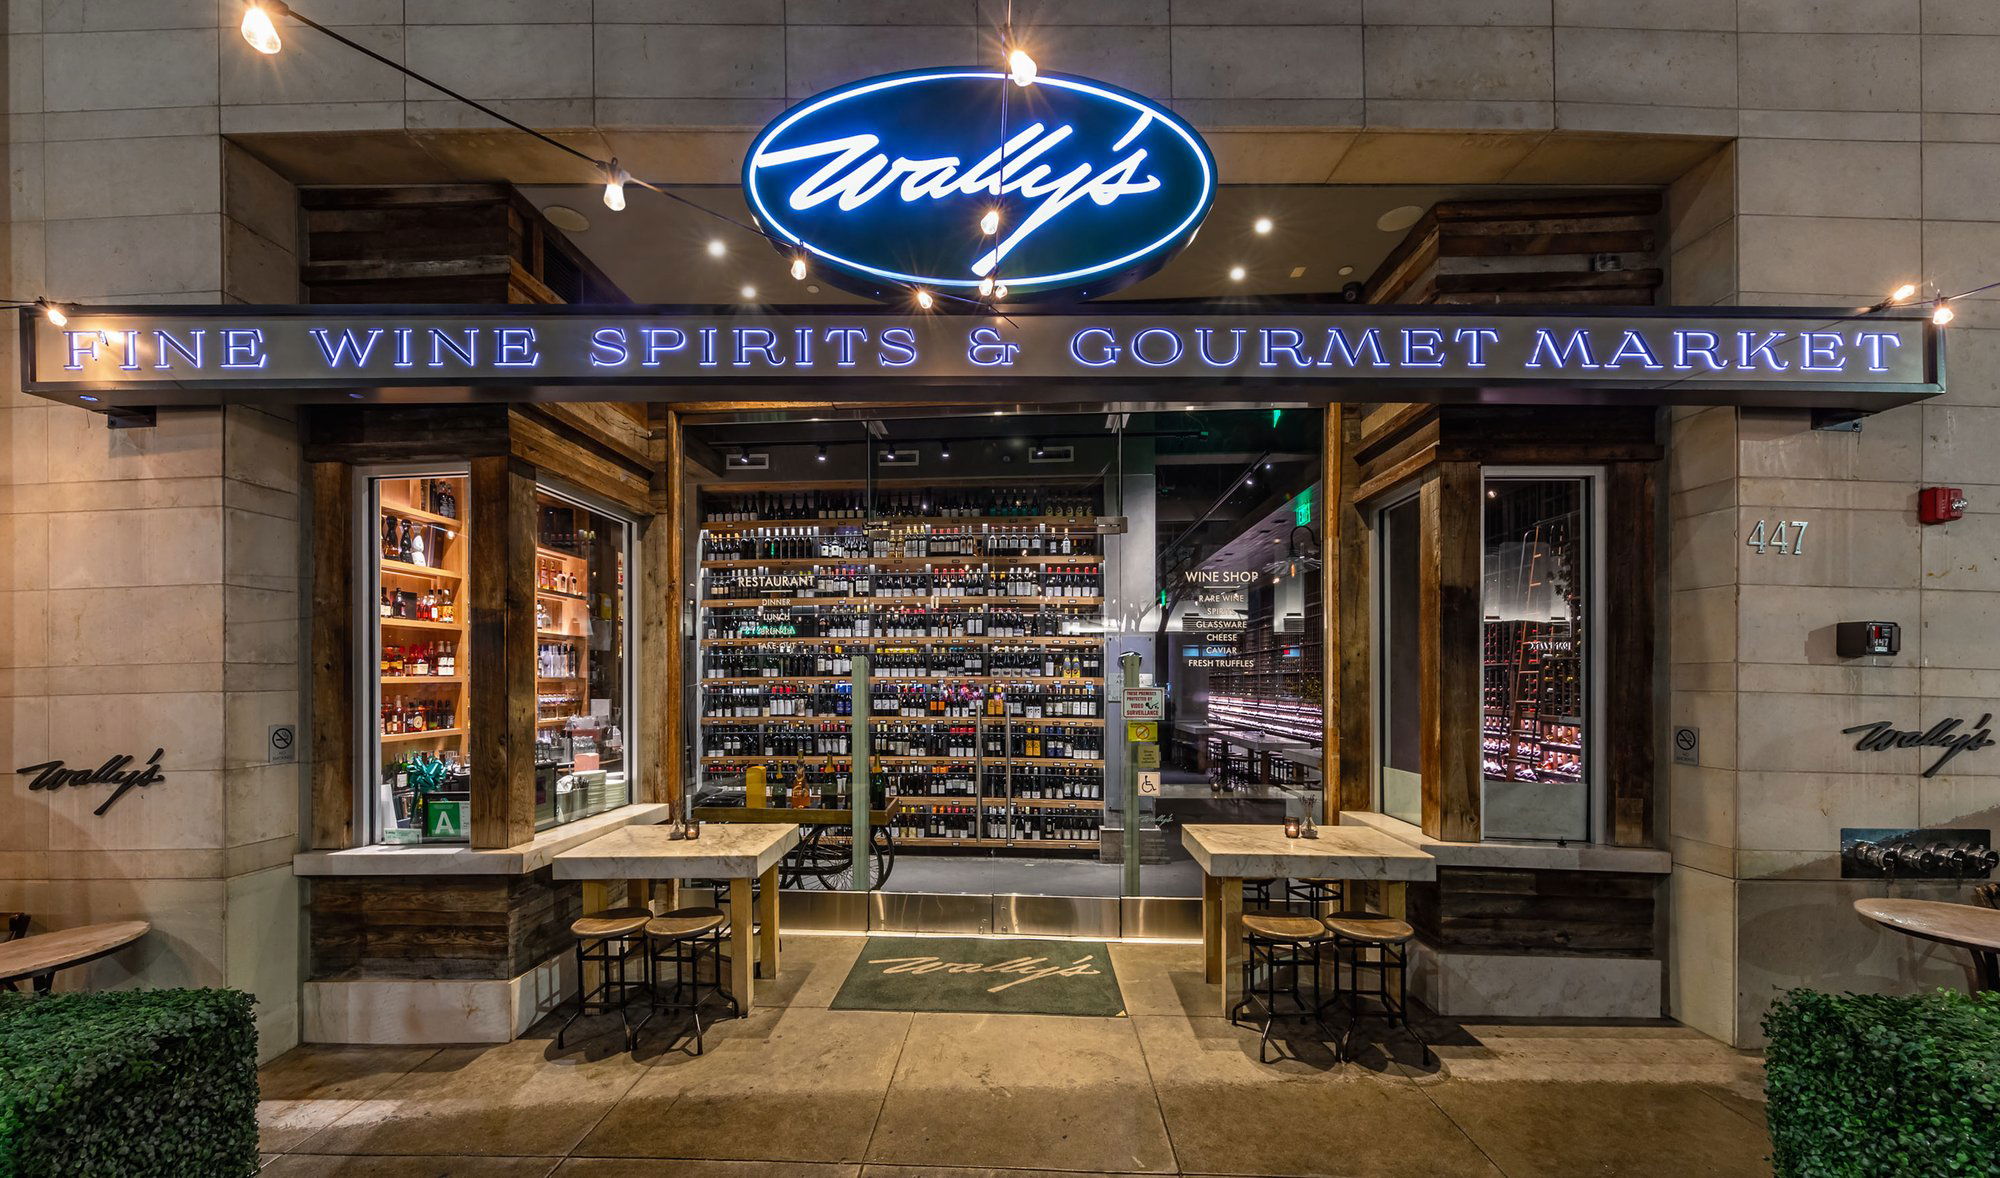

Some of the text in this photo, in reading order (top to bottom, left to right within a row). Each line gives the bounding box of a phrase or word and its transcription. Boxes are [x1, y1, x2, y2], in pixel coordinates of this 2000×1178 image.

[757, 110, 1161, 277] Wally's
[63, 327, 1901, 371] FINE WINE SPIRITS & GOURMET MARKET
[1746, 519, 1809, 555] 447
[738, 575, 815, 588] RESTAURANT
[1185, 571, 1259, 583] WINE SHOP
[761, 598, 791, 606] DINNER
[1198, 594, 1244, 603] RARE WINE
[763, 612, 791, 621] LUNCH
[1195, 620, 1248, 629] GLASSWARE
[1206, 633, 1238, 642] CHEESE
[757, 641, 797, 650] TAKE-OUT
[1205, 645, 1238, 655] CAVIAR
[1188, 659, 1255, 668] FRESH TRUFFLES
[1842, 712, 1996, 778] Wally's
[16, 747, 166, 816] Wally's
[434, 810, 456, 835] A
[868, 954, 1101, 993] Wally's
